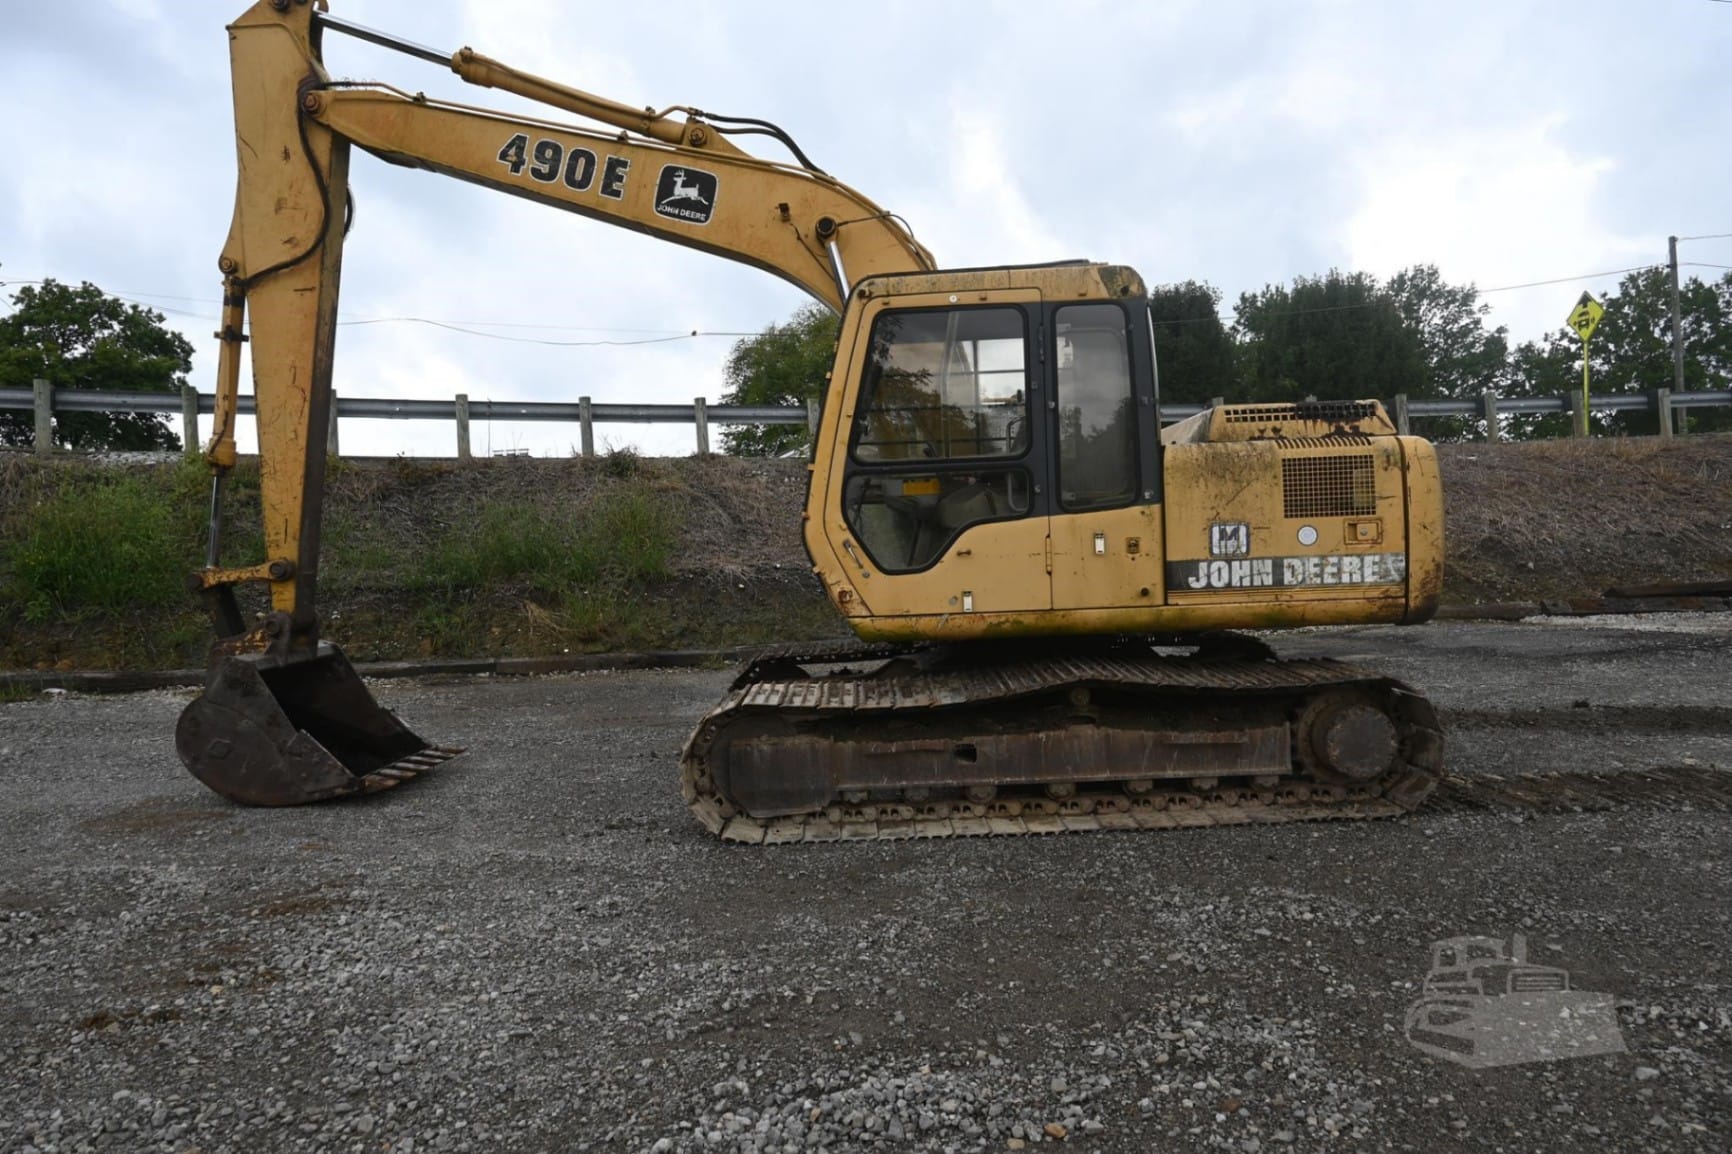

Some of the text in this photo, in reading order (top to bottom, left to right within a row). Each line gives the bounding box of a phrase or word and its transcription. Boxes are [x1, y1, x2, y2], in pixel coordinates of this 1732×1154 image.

[496, 132, 631, 200] 490E
[657, 204, 707, 221] JOHN DEERE
[1188, 555, 1382, 589] JOHN DEERE
